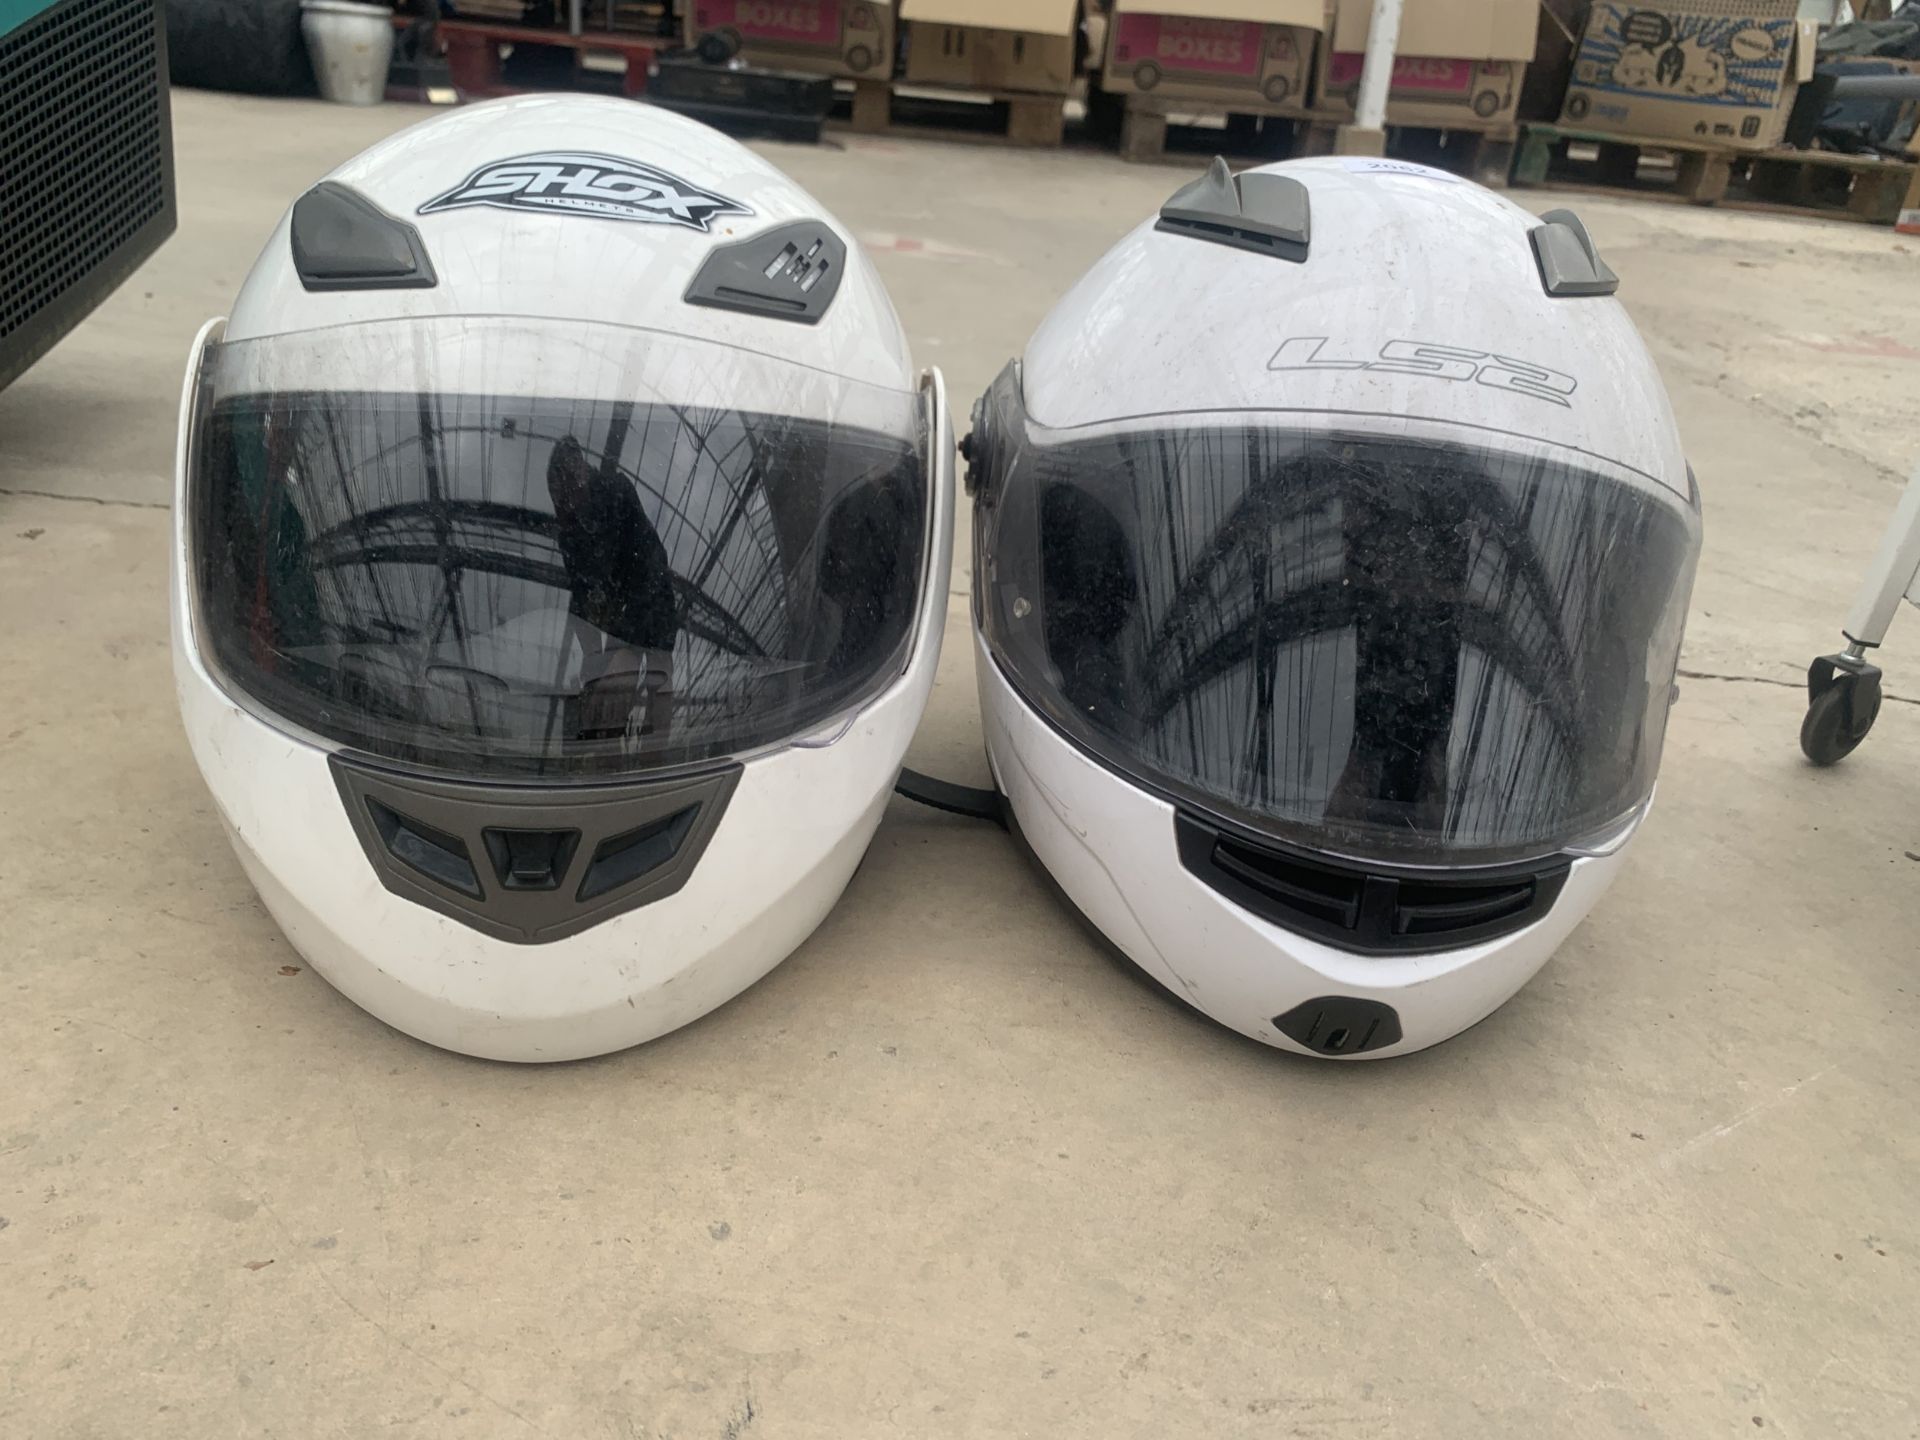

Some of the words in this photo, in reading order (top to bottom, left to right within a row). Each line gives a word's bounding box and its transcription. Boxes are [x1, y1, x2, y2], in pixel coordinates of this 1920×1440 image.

[1157, 34, 1242, 63] BOXES
[454, 165, 724, 219] SHOX
[544, 198, 634, 213] HELMETS
[1266, 336, 1578, 409] LS2
